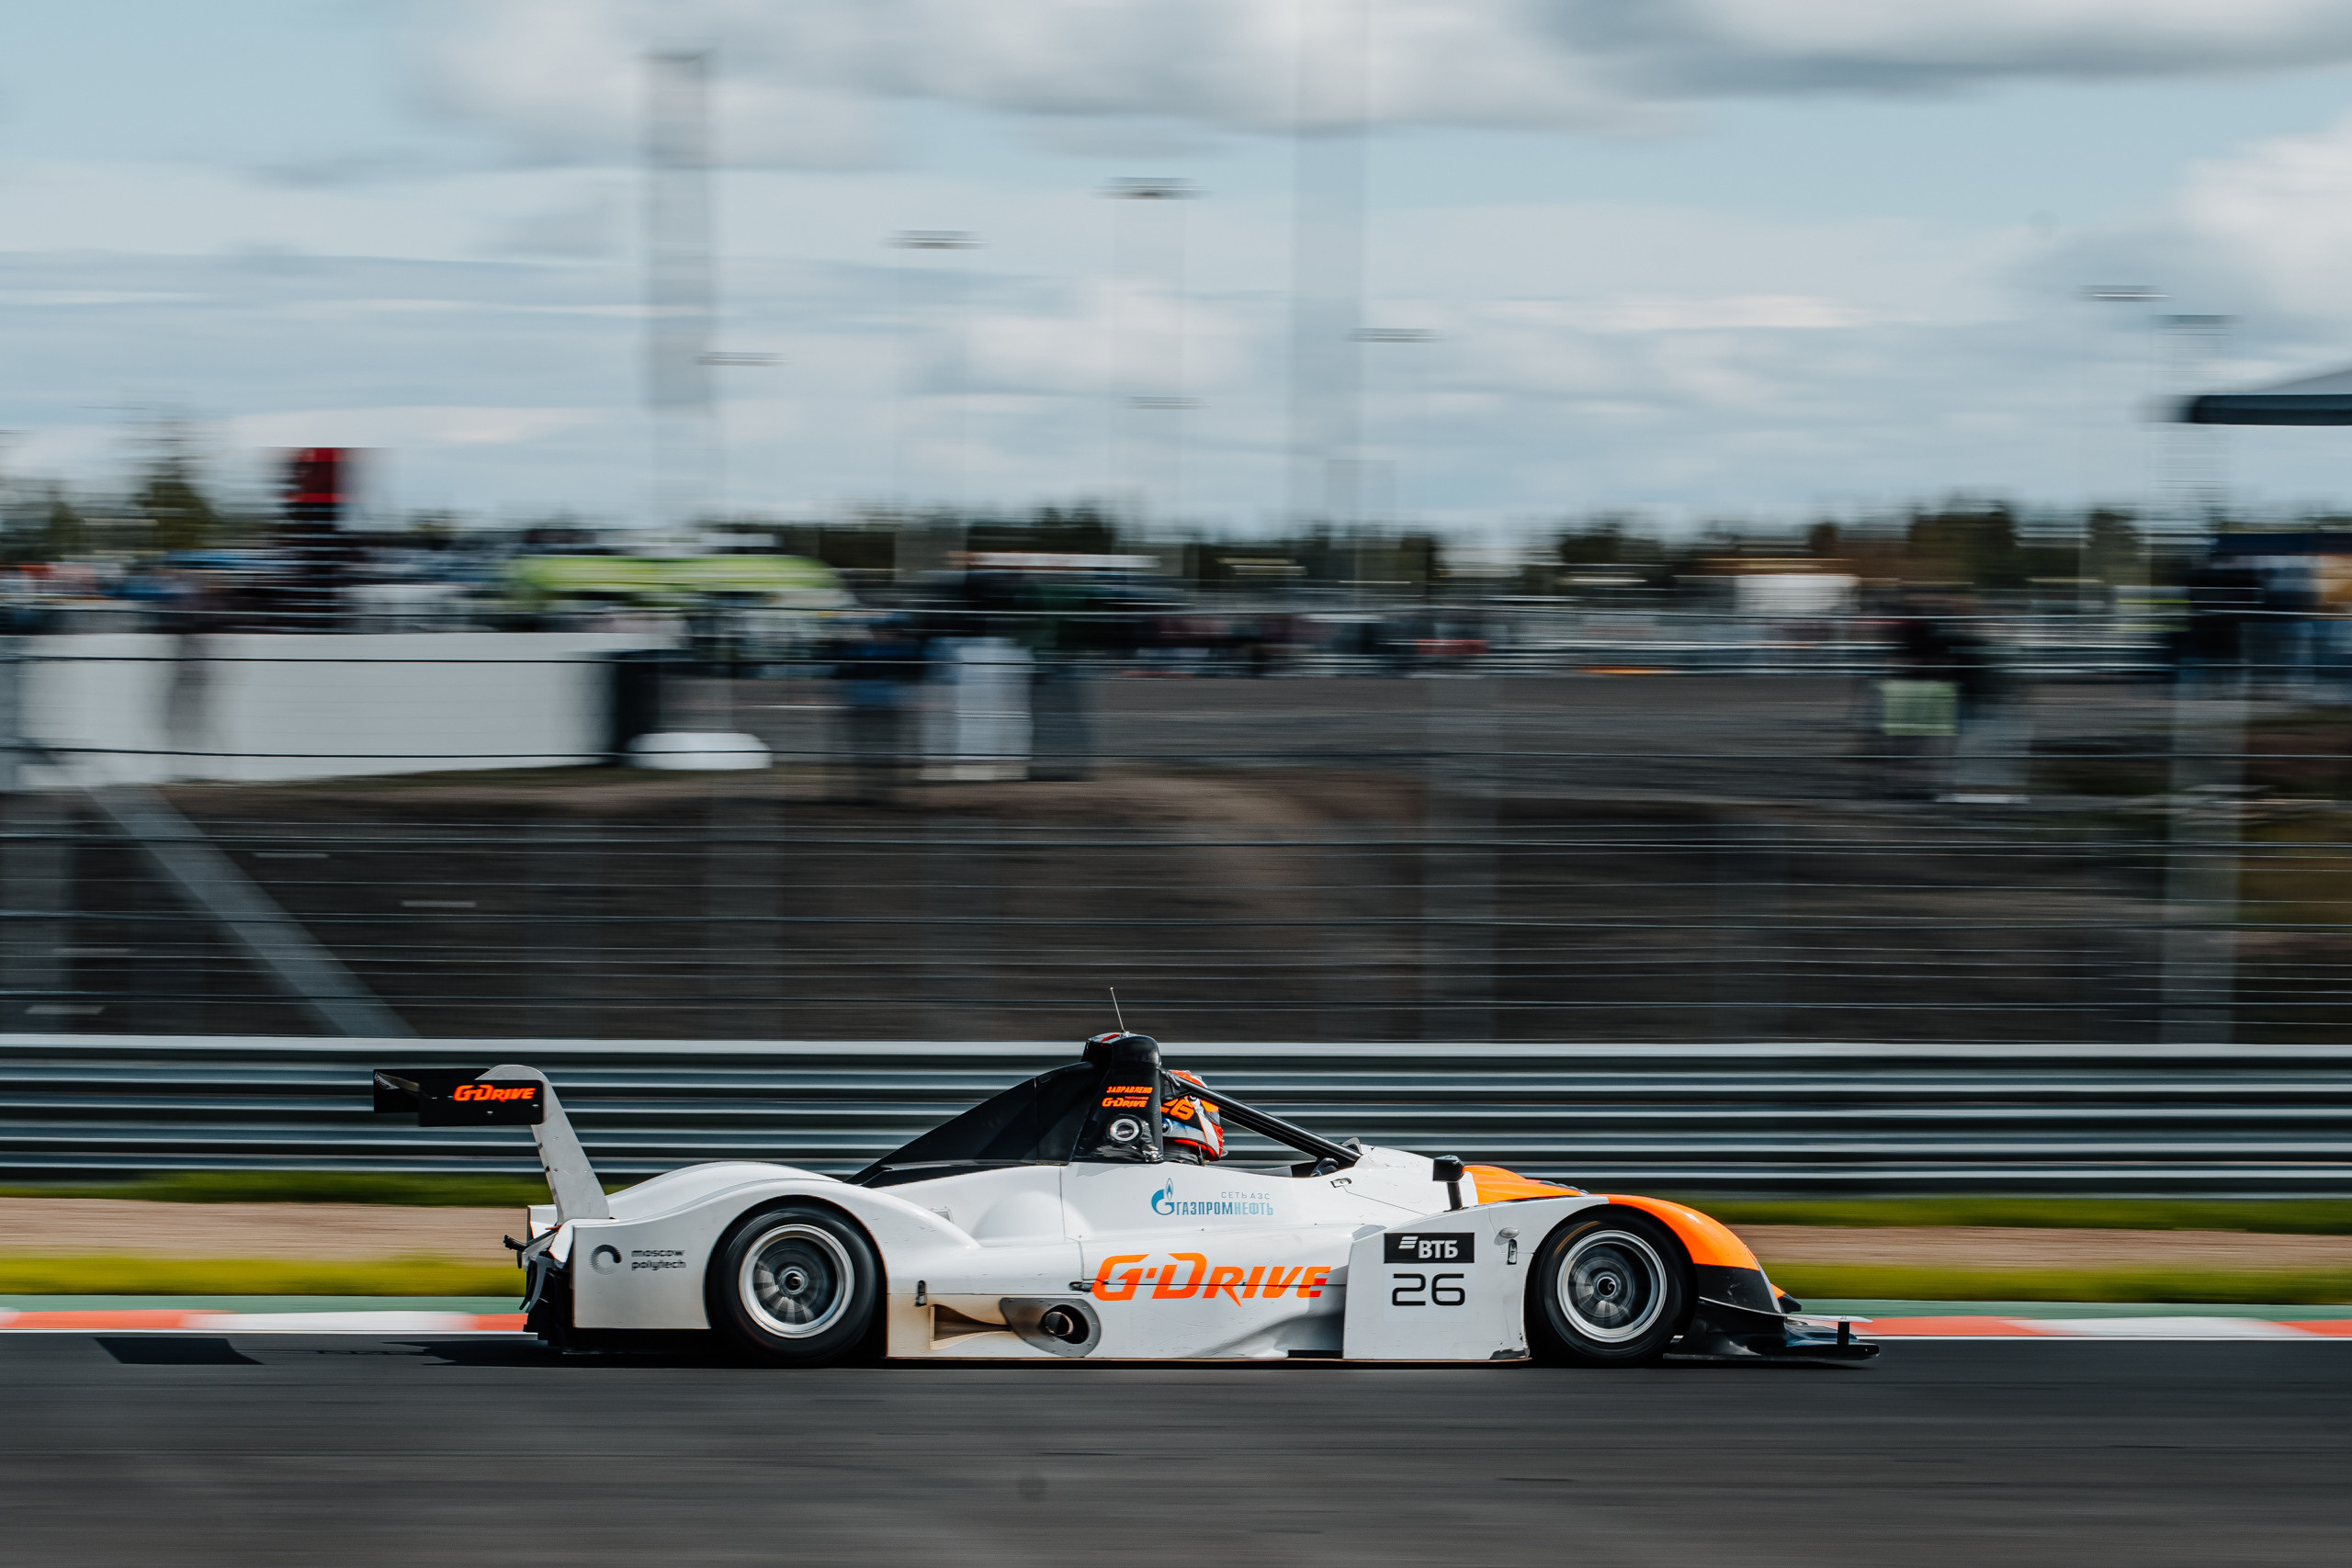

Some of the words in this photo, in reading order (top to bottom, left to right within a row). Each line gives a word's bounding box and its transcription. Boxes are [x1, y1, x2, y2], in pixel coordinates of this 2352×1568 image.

[1106, 1086, 1153, 1094] ЗАПРАВЛЕНО
[1176, 1201, 1274, 1215] ГАЗПРОМНЕФТЬ
[1418, 1240, 1459, 1258] ВТБ
[631, 1259, 686, 1271] polytech
[1392, 1273, 1465, 1306] 26
